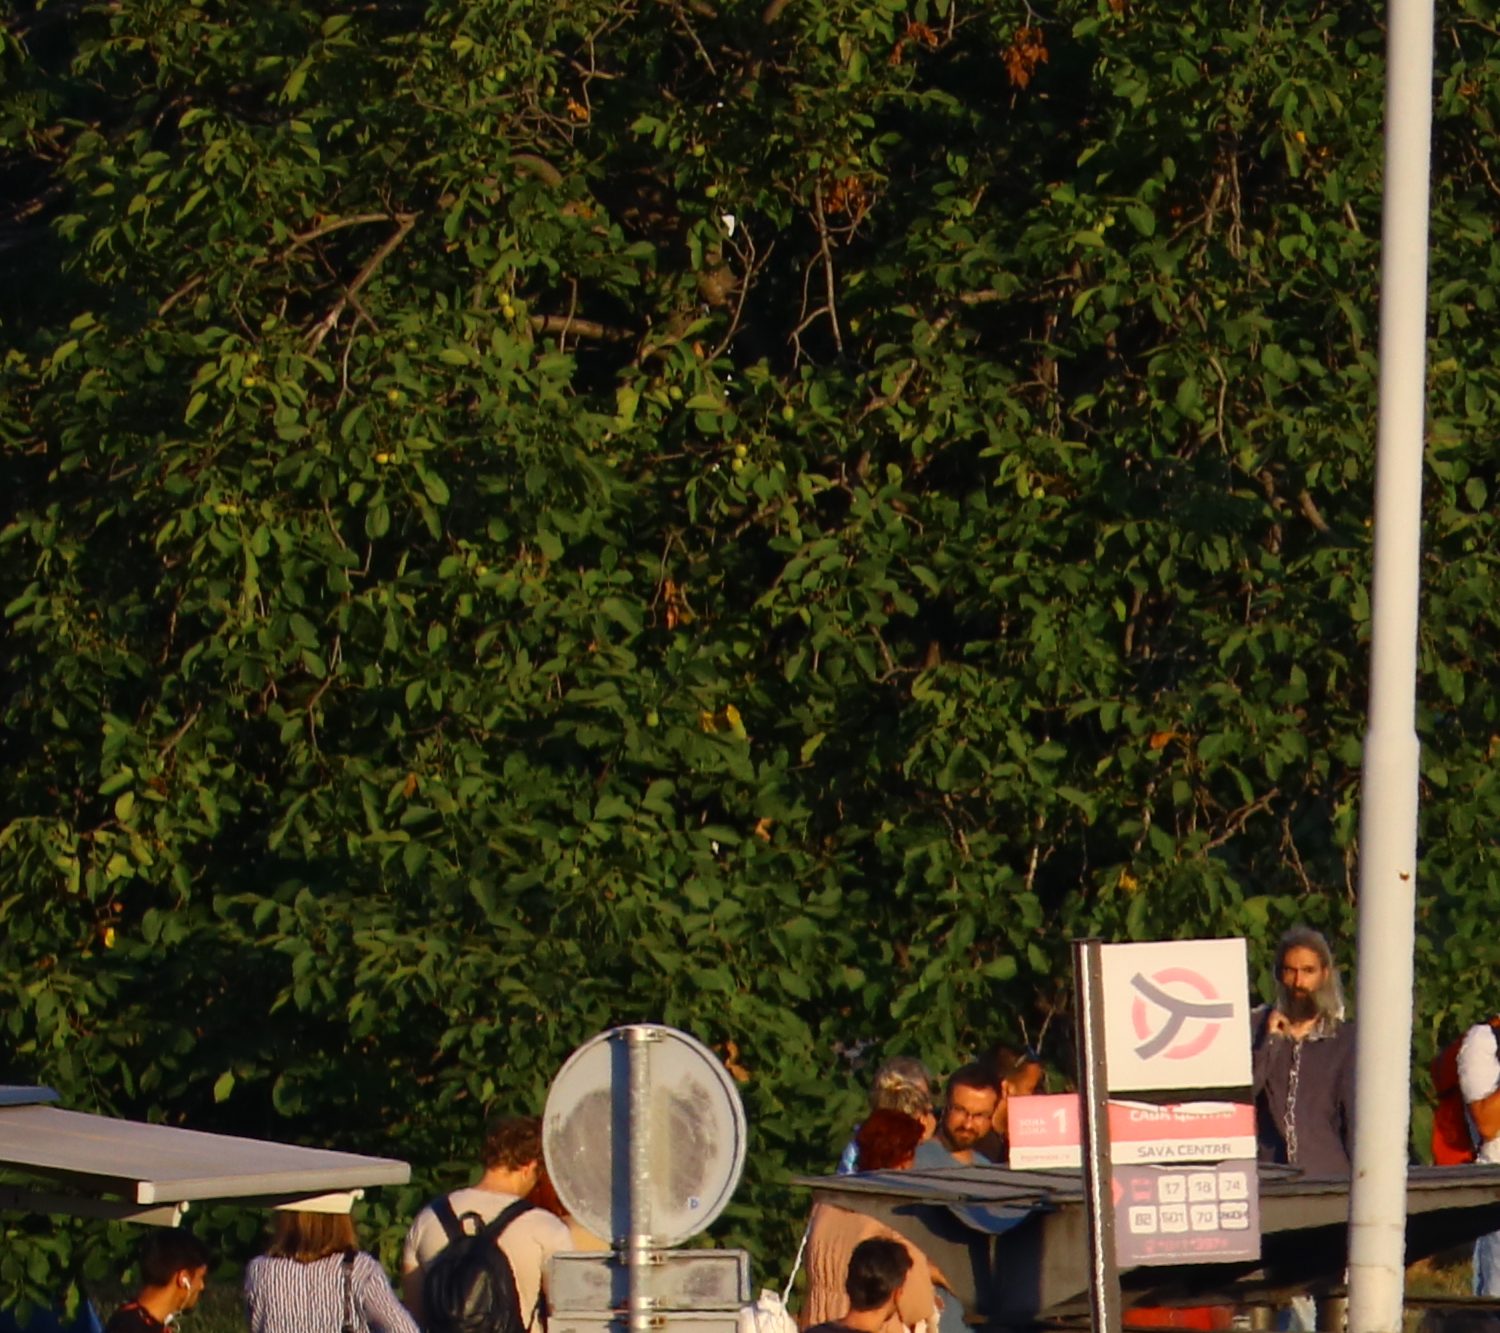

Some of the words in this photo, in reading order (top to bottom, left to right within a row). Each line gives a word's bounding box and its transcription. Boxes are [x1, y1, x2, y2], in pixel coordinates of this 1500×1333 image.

[1053, 1108, 1067, 1134] 1
[1137, 1145, 1173, 1158] SAVA
[1178, 1143, 1231, 1156] CENTAR
[1164, 1182, 1180, 1194] 17
[1195, 1181, 1211, 1193] 18
[1226, 1180, 1241, 1191] 74
